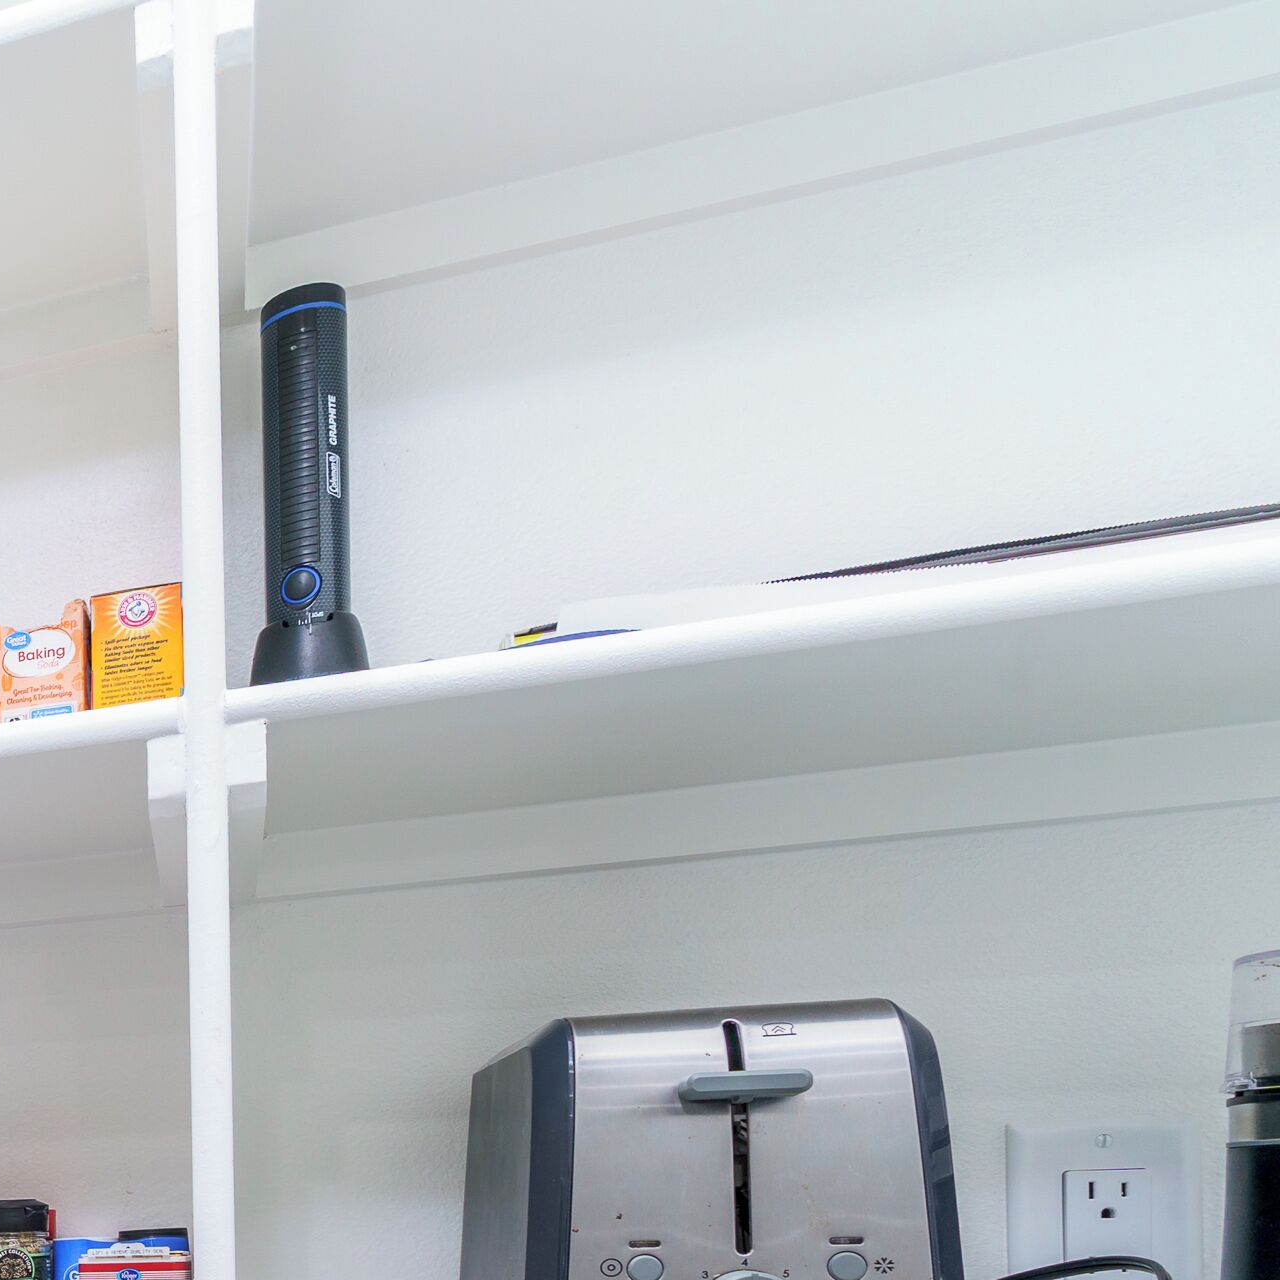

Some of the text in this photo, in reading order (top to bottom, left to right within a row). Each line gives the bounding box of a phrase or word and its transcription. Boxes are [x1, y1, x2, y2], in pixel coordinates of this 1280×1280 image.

[329, 394, 337, 446] GRAPHITE
[18, 647, 65, 662] Baking
[741, 1258, 748, 1267] 4
[702, 1270, 709, 1279] 3
[783, 1269, 790, 1279] 5
